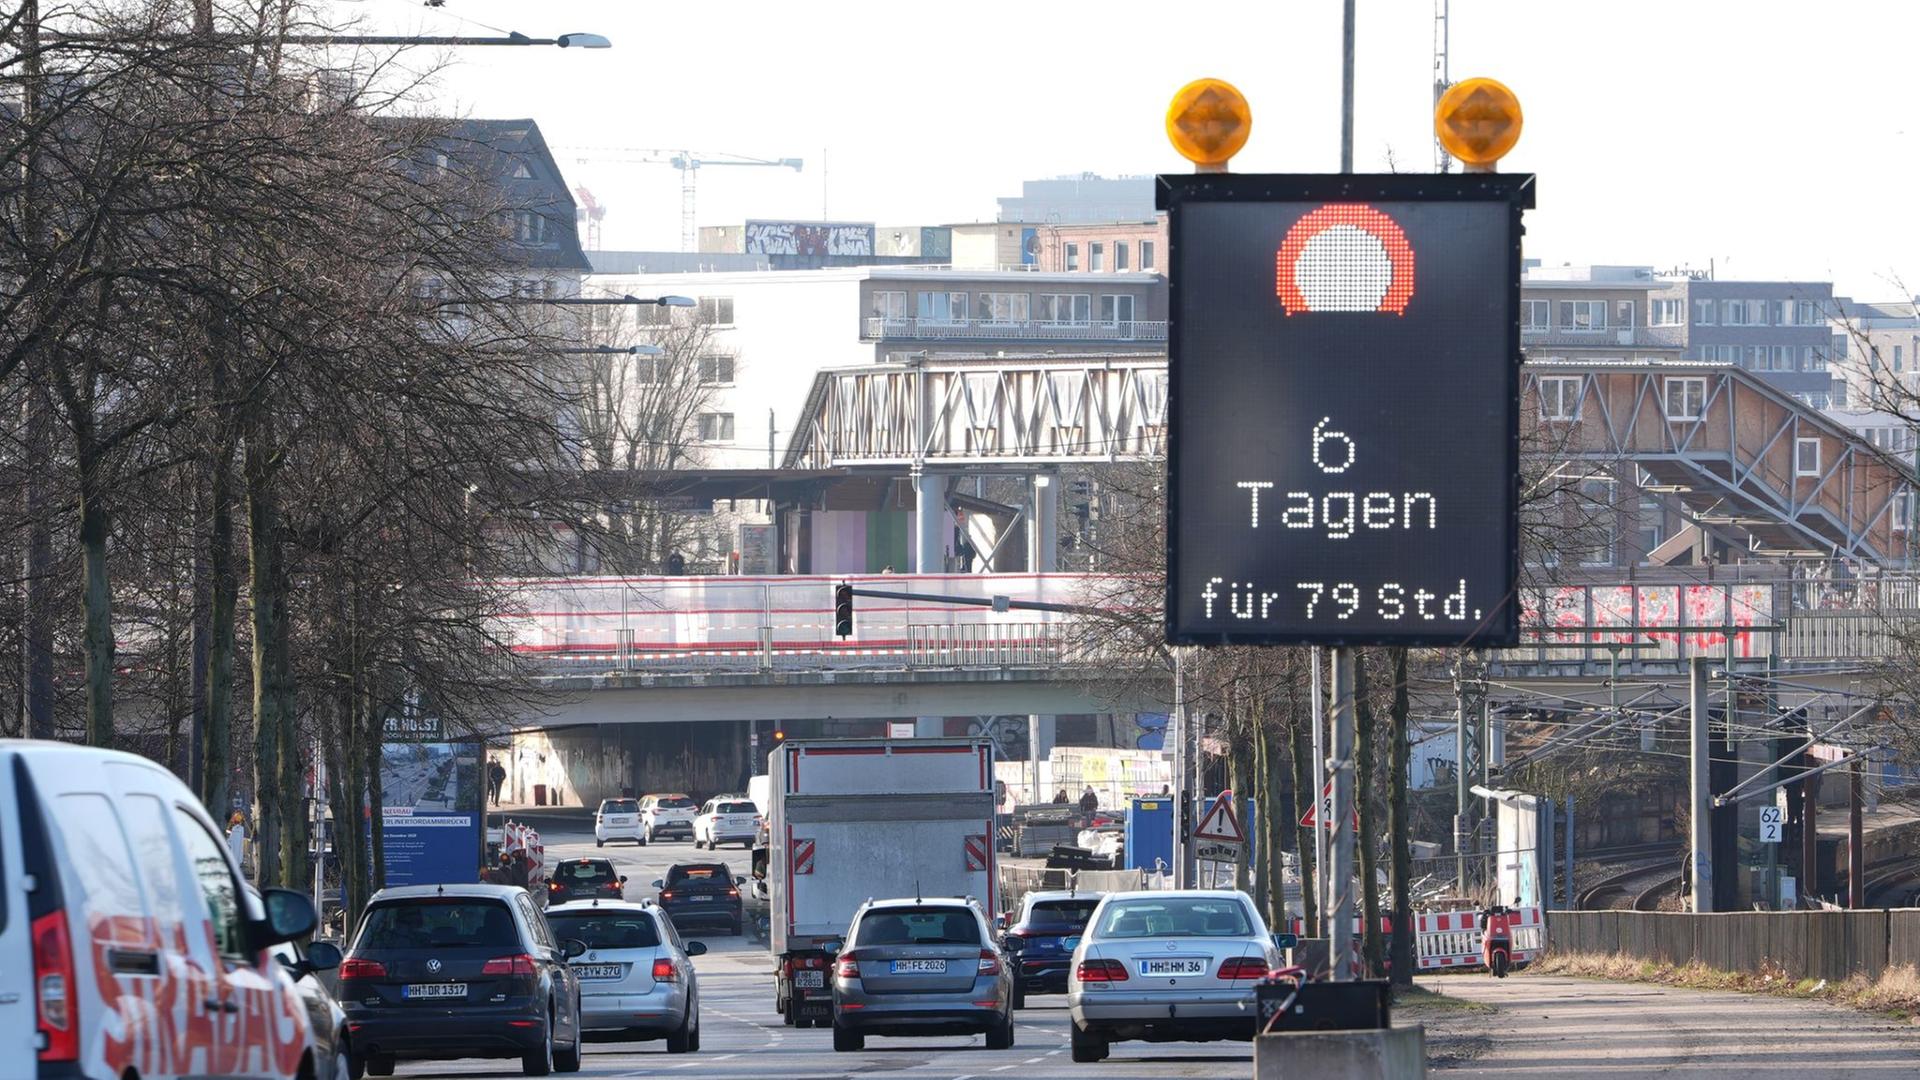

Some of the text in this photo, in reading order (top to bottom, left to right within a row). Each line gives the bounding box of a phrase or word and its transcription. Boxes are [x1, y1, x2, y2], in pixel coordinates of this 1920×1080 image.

[1313, 417, 1355, 473] 6
[1237, 481, 1436, 539] Tagen
[1201, 577, 1481, 620] für 79 Std.
[1761, 808, 1780, 823] 62
[1766, 825, 1776, 839] 2
[602, 966, 619, 976] 370
[896, 959, 946, 971] HH FE 2026
[1150, 960, 1200, 972] HH HM 36
[409, 985, 465, 997] HH DR 1317
